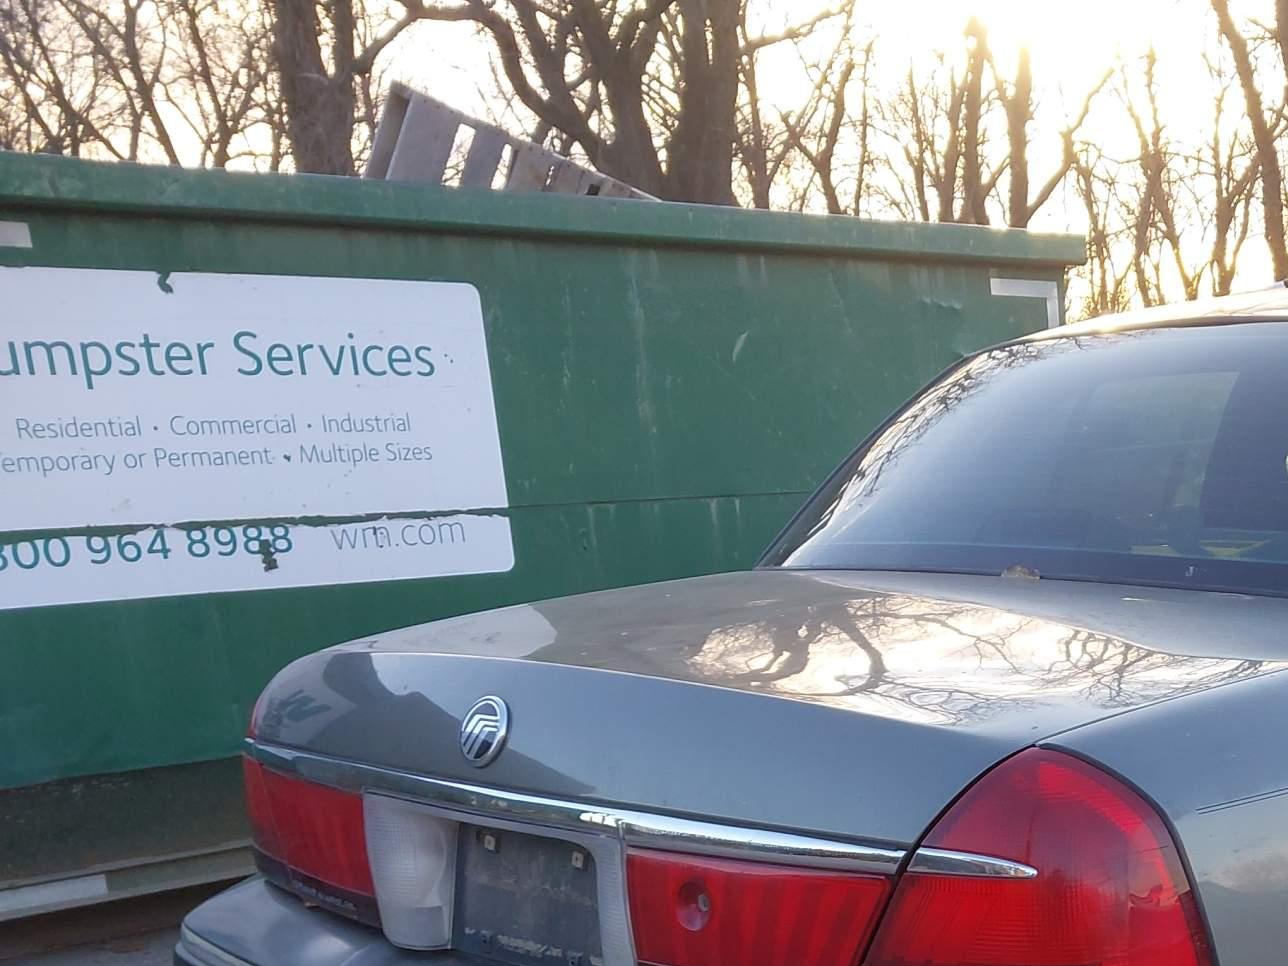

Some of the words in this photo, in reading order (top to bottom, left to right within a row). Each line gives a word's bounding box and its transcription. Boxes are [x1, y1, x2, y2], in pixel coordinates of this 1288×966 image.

[232, 331, 435, 377] Services
[15, 416, 142, 440] Residential
[169, 414, 297, 436] Commercial
[322, 412, 411, 433] Industrial
[0, 452, 115, 477] emporary
[123, 453, 146, 468] or
[153, 447, 273, 468] Permanent
[300, 442, 379, 467] Multiple
[385, 442, 433, 462] Sizes
[86, 529, 171, 564] 964
[186, 525, 293, 558] 8988
[329, 521, 466, 551] wm.com
